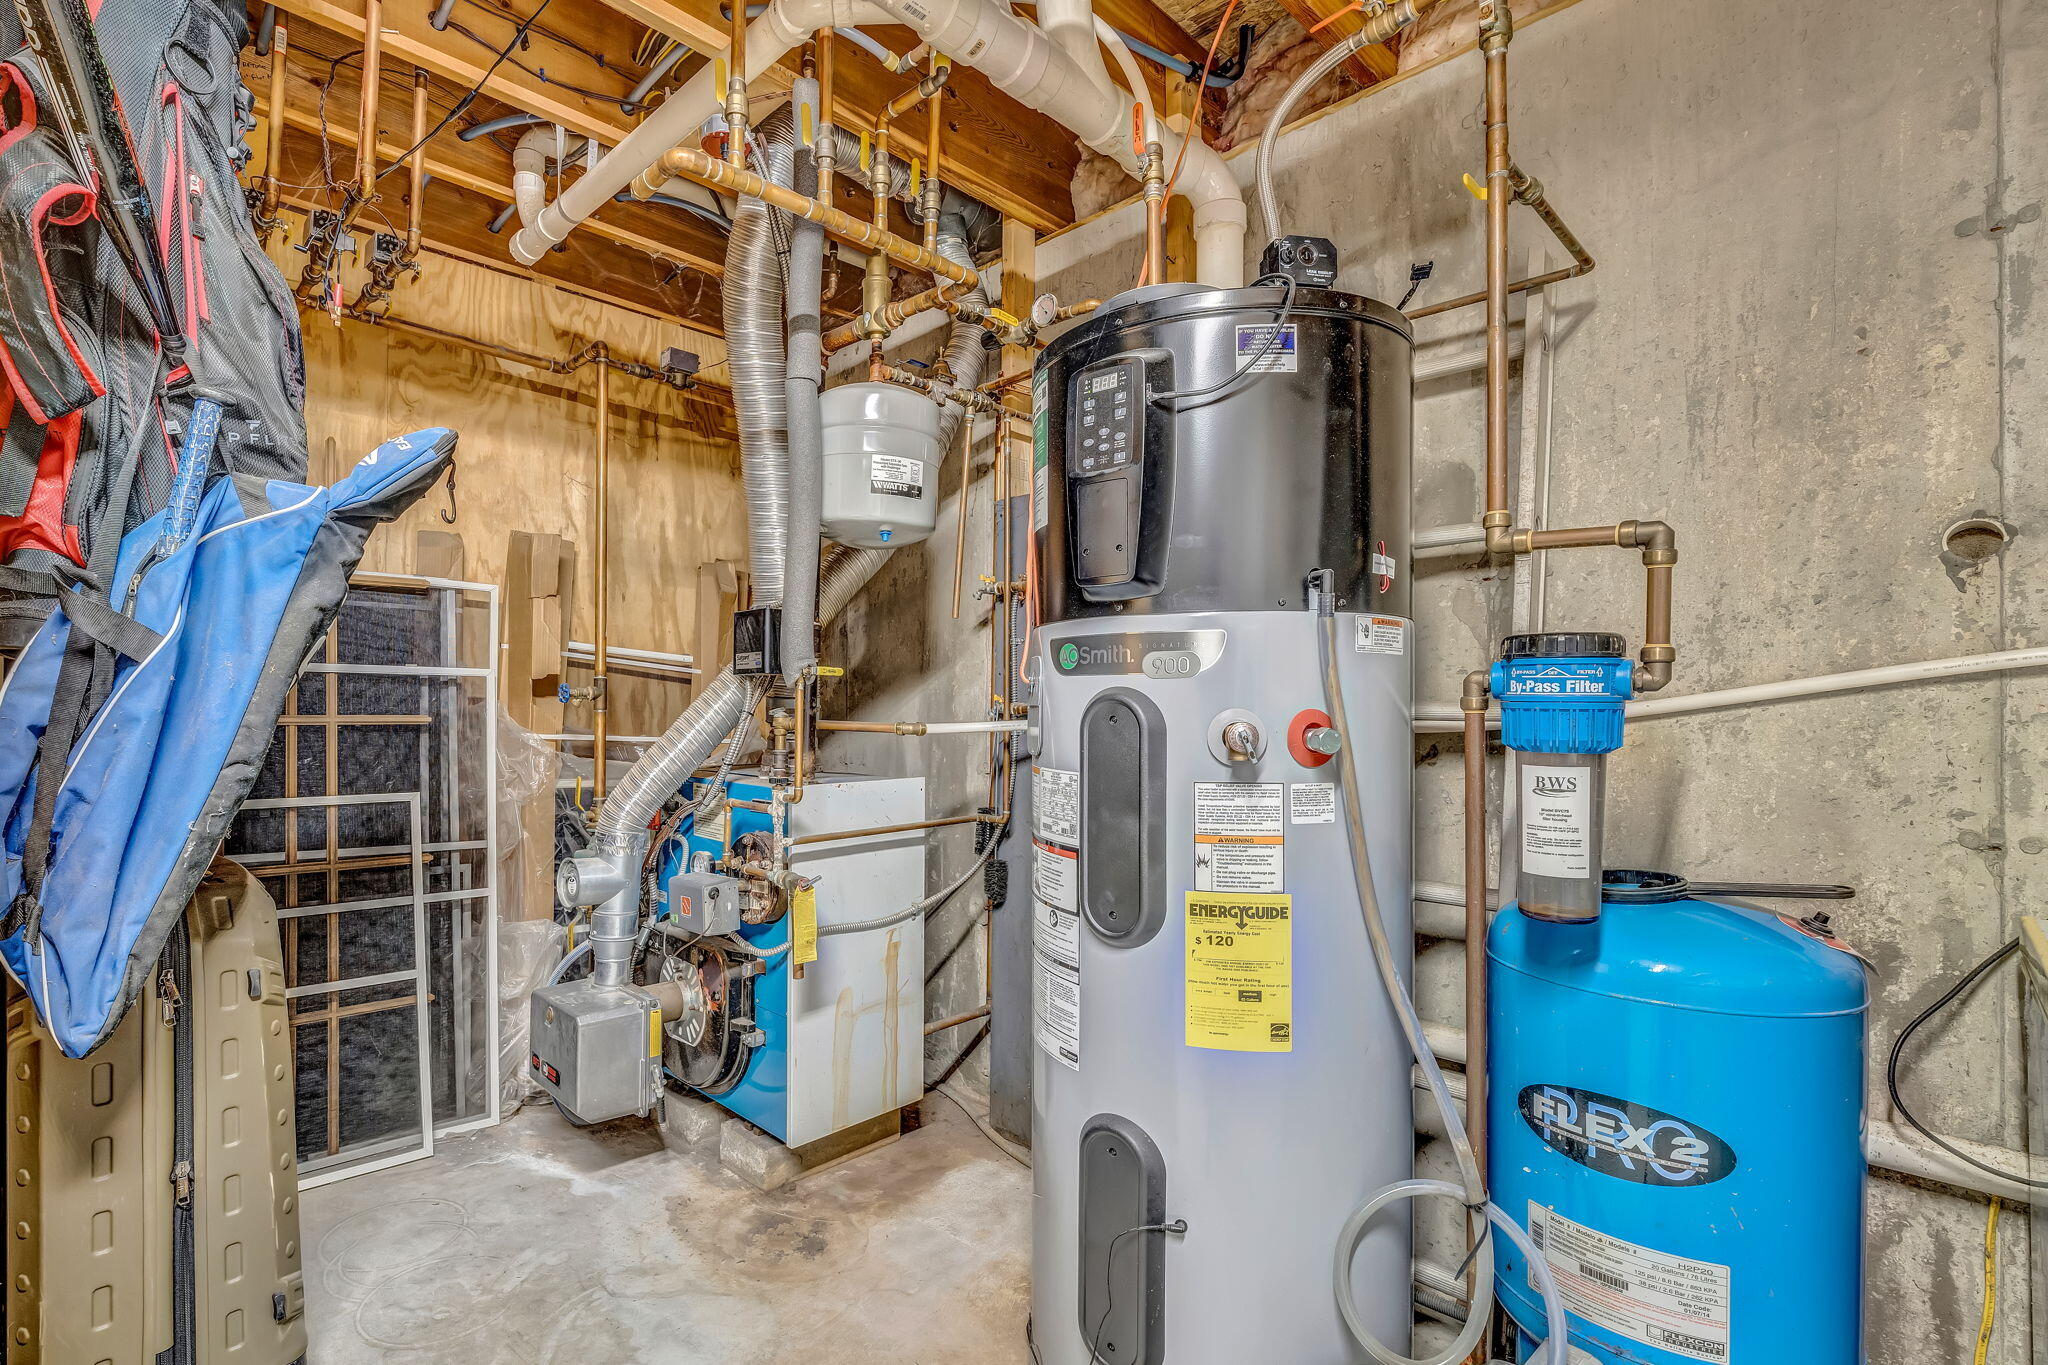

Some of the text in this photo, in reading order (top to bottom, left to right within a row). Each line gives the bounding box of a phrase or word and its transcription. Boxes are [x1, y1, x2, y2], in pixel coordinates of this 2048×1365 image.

[1152, 657, 1189, 674] 900
[1510, 680, 1604, 694] By-Pass Filter
[1535, 776, 1577, 789] BWS
[1190, 904, 1288, 920] ENERGYGUIDE
[1195, 935, 1234, 946] $ 120
[1550, 1215, 1565, 1227] Model
[1576, 1227, 1596, 1240] Modelo
[1660, 1265, 1685, 1278] Gallons
[1699, 1275, 1717, 1284] Litres
[1677, 1263, 1714, 1276] H2P20
[1634, 1269, 1646, 1277] 125
[1647, 1272, 1657, 1281] psi
[1673, 1278, 1685, 1287] Bar
[1704, 1285, 1717, 1295] KPA
[1649, 1282, 1658, 1291] psi
[1675, 1288, 1685, 1297] Bar
[1704, 1295, 1719, 1304] KPA
[1677, 1300, 1712, 1313] Date Code:
[1664, 1331, 1723, 1349] FLEXCON
